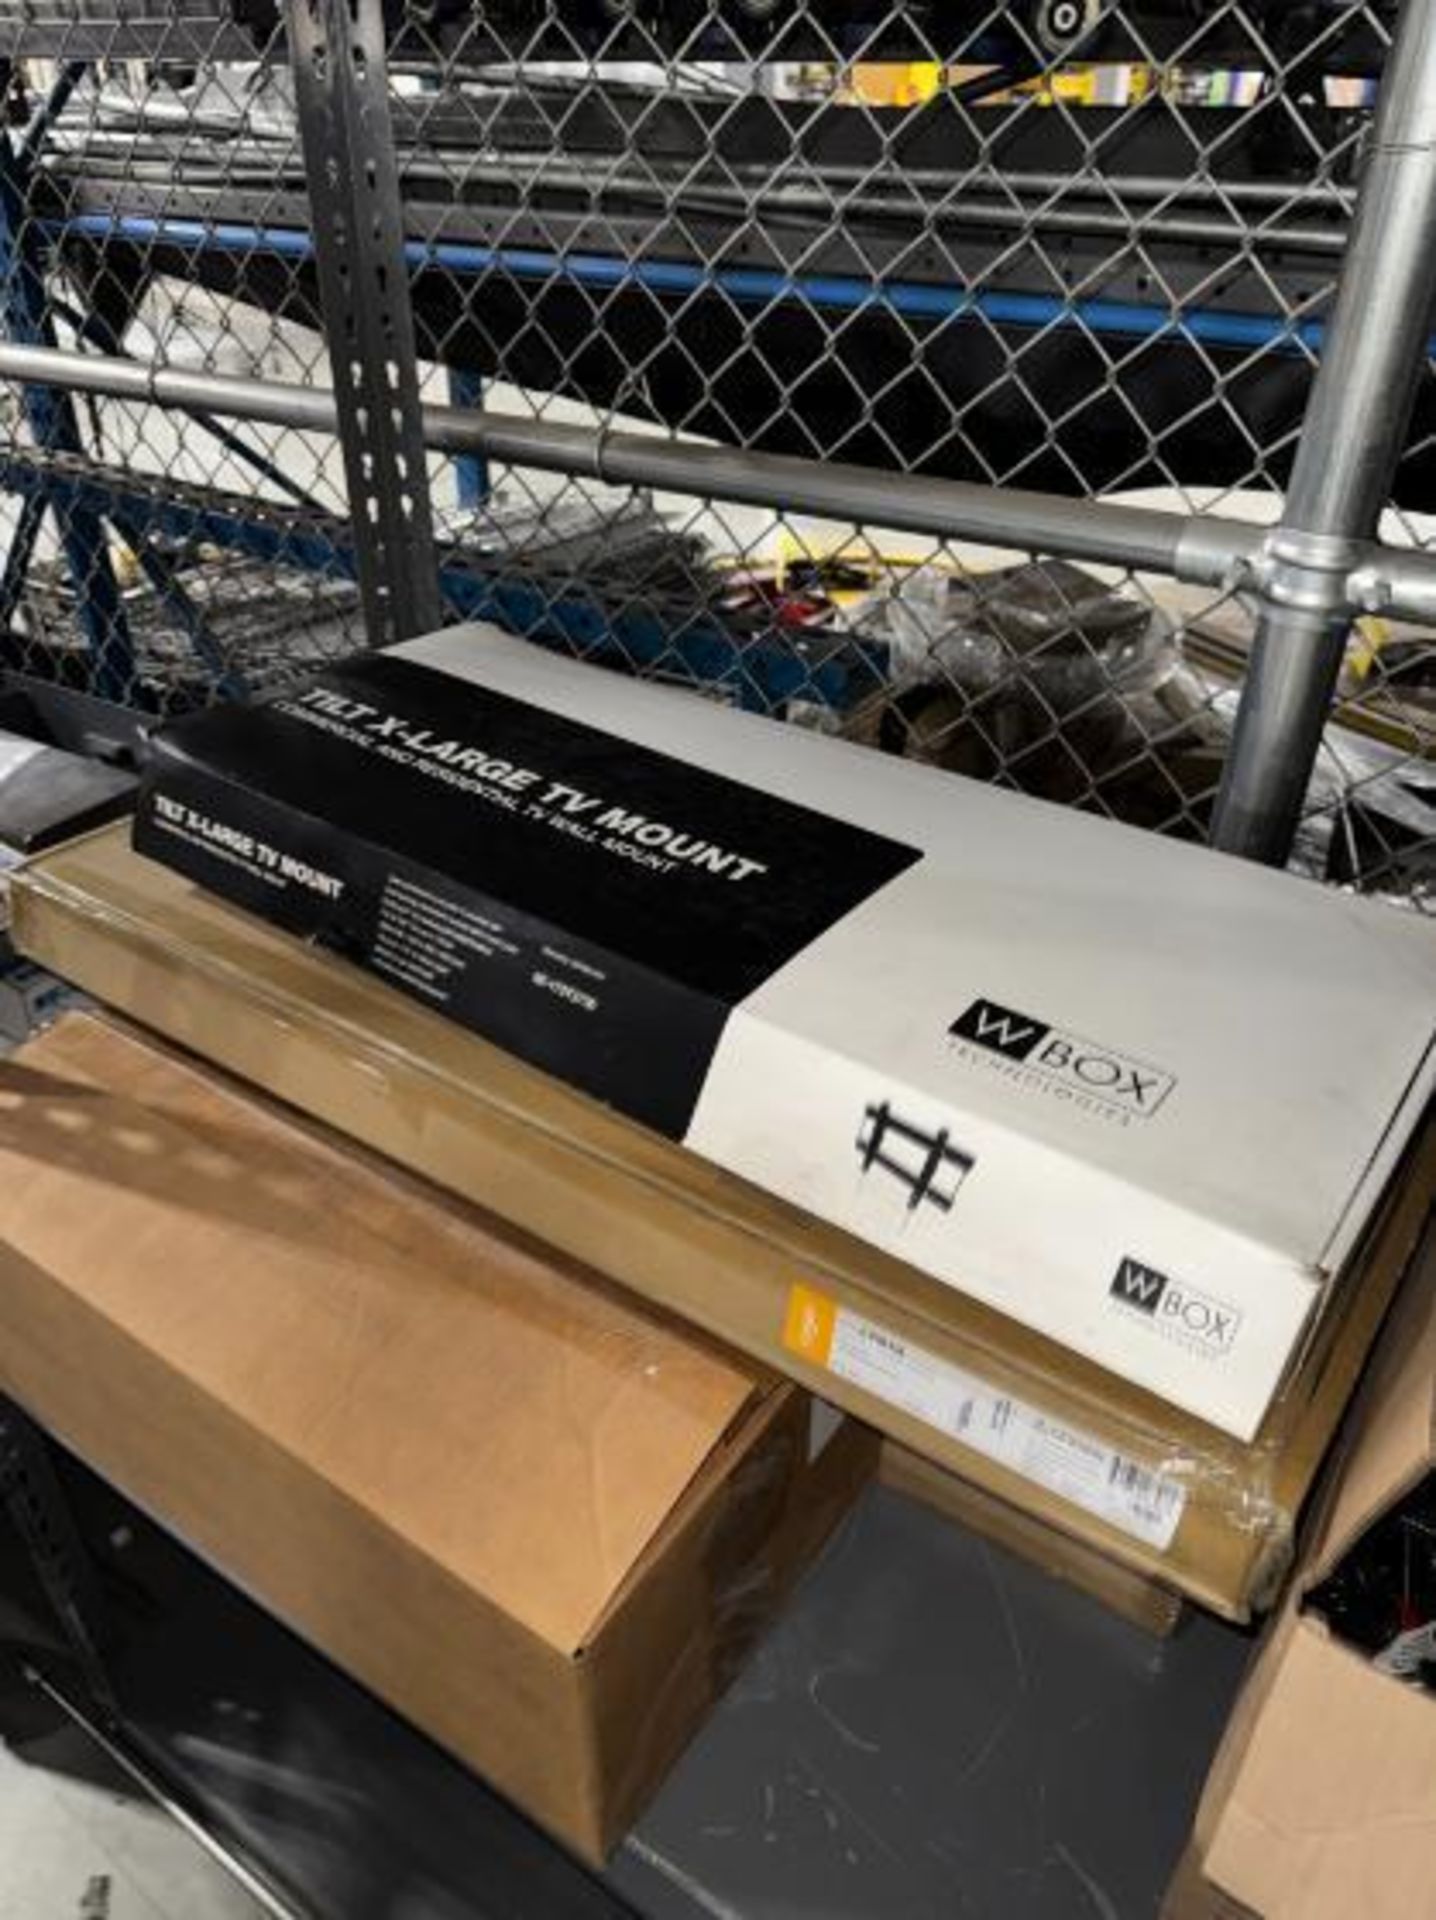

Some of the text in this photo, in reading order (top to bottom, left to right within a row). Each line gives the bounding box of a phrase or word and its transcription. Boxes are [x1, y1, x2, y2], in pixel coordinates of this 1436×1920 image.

[302, 687, 768, 881] TILT X-LARGE TV MOUNT
[257, 843, 280, 867] TV
[279, 854, 345, 899] MOUNT
[549, 812, 599, 843] WALL
[601, 836, 679, 874] MOUNT
